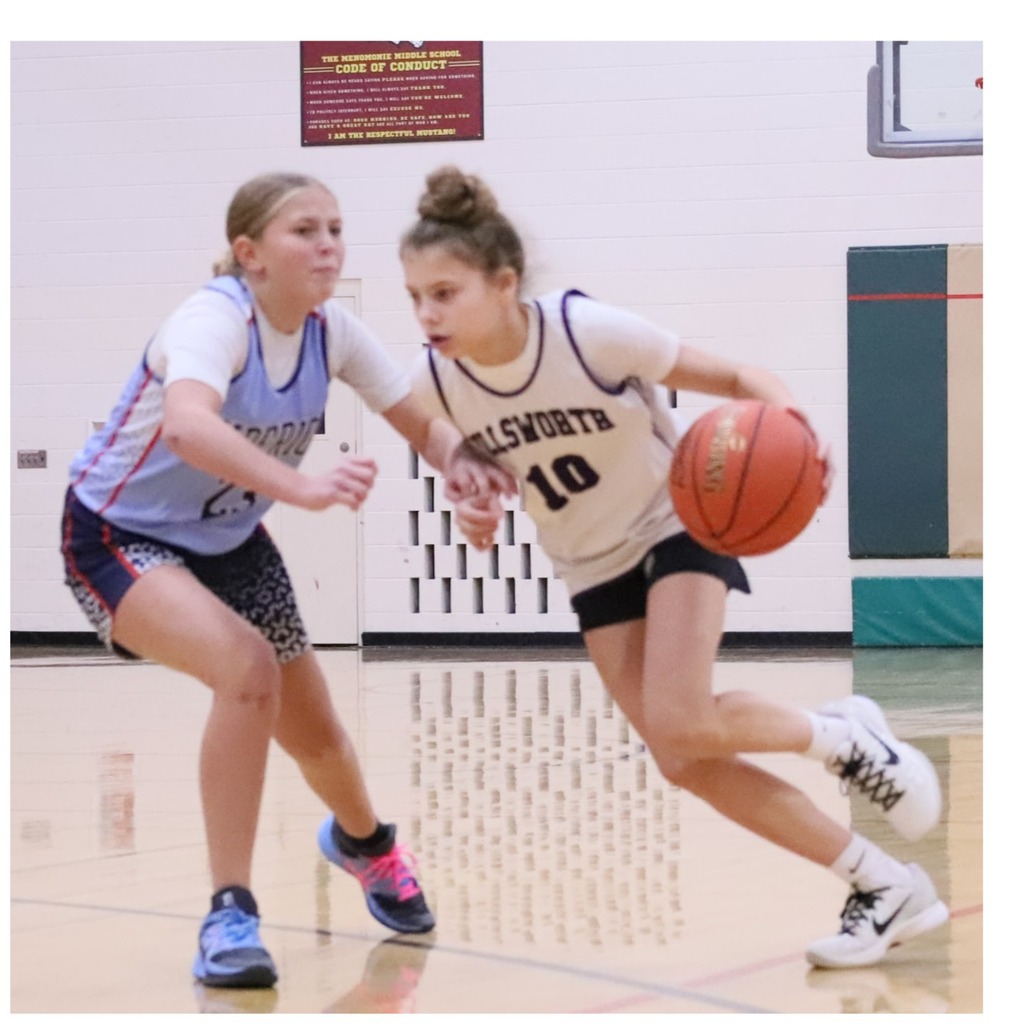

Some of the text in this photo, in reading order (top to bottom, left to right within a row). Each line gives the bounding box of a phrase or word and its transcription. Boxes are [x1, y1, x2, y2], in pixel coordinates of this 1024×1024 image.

[341, 53, 392, 62] MENOMONIE
[429, 50, 461, 58] SCHOOL
[336, 60, 447, 74] CODE OF CONDUCT
[527, 453, 600, 511] 10
